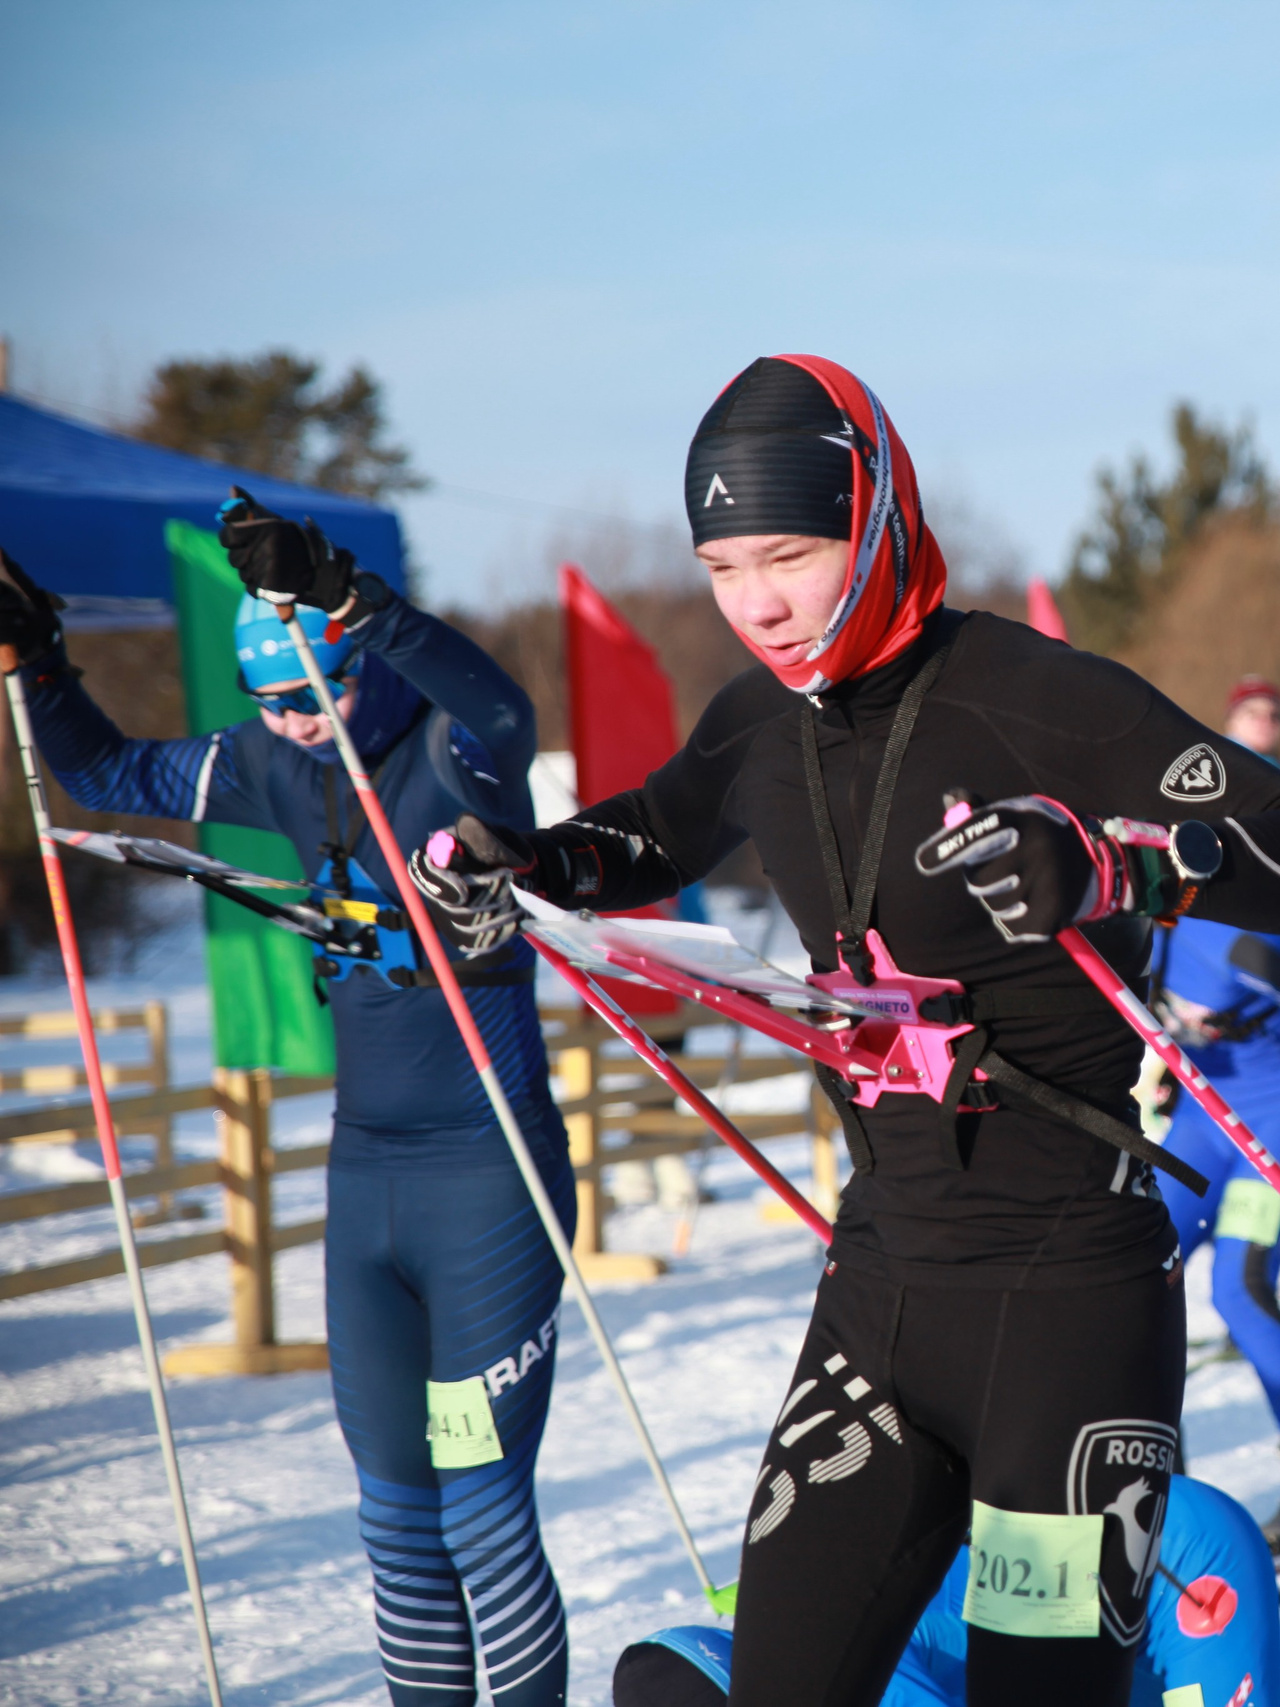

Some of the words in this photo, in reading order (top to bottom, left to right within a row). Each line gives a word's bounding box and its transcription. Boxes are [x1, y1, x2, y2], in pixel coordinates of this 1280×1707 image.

[937, 832, 965, 860] SKI
[964, 812, 1000, 841] TIME
[975, 1549, 1072, 1600] 202.1
